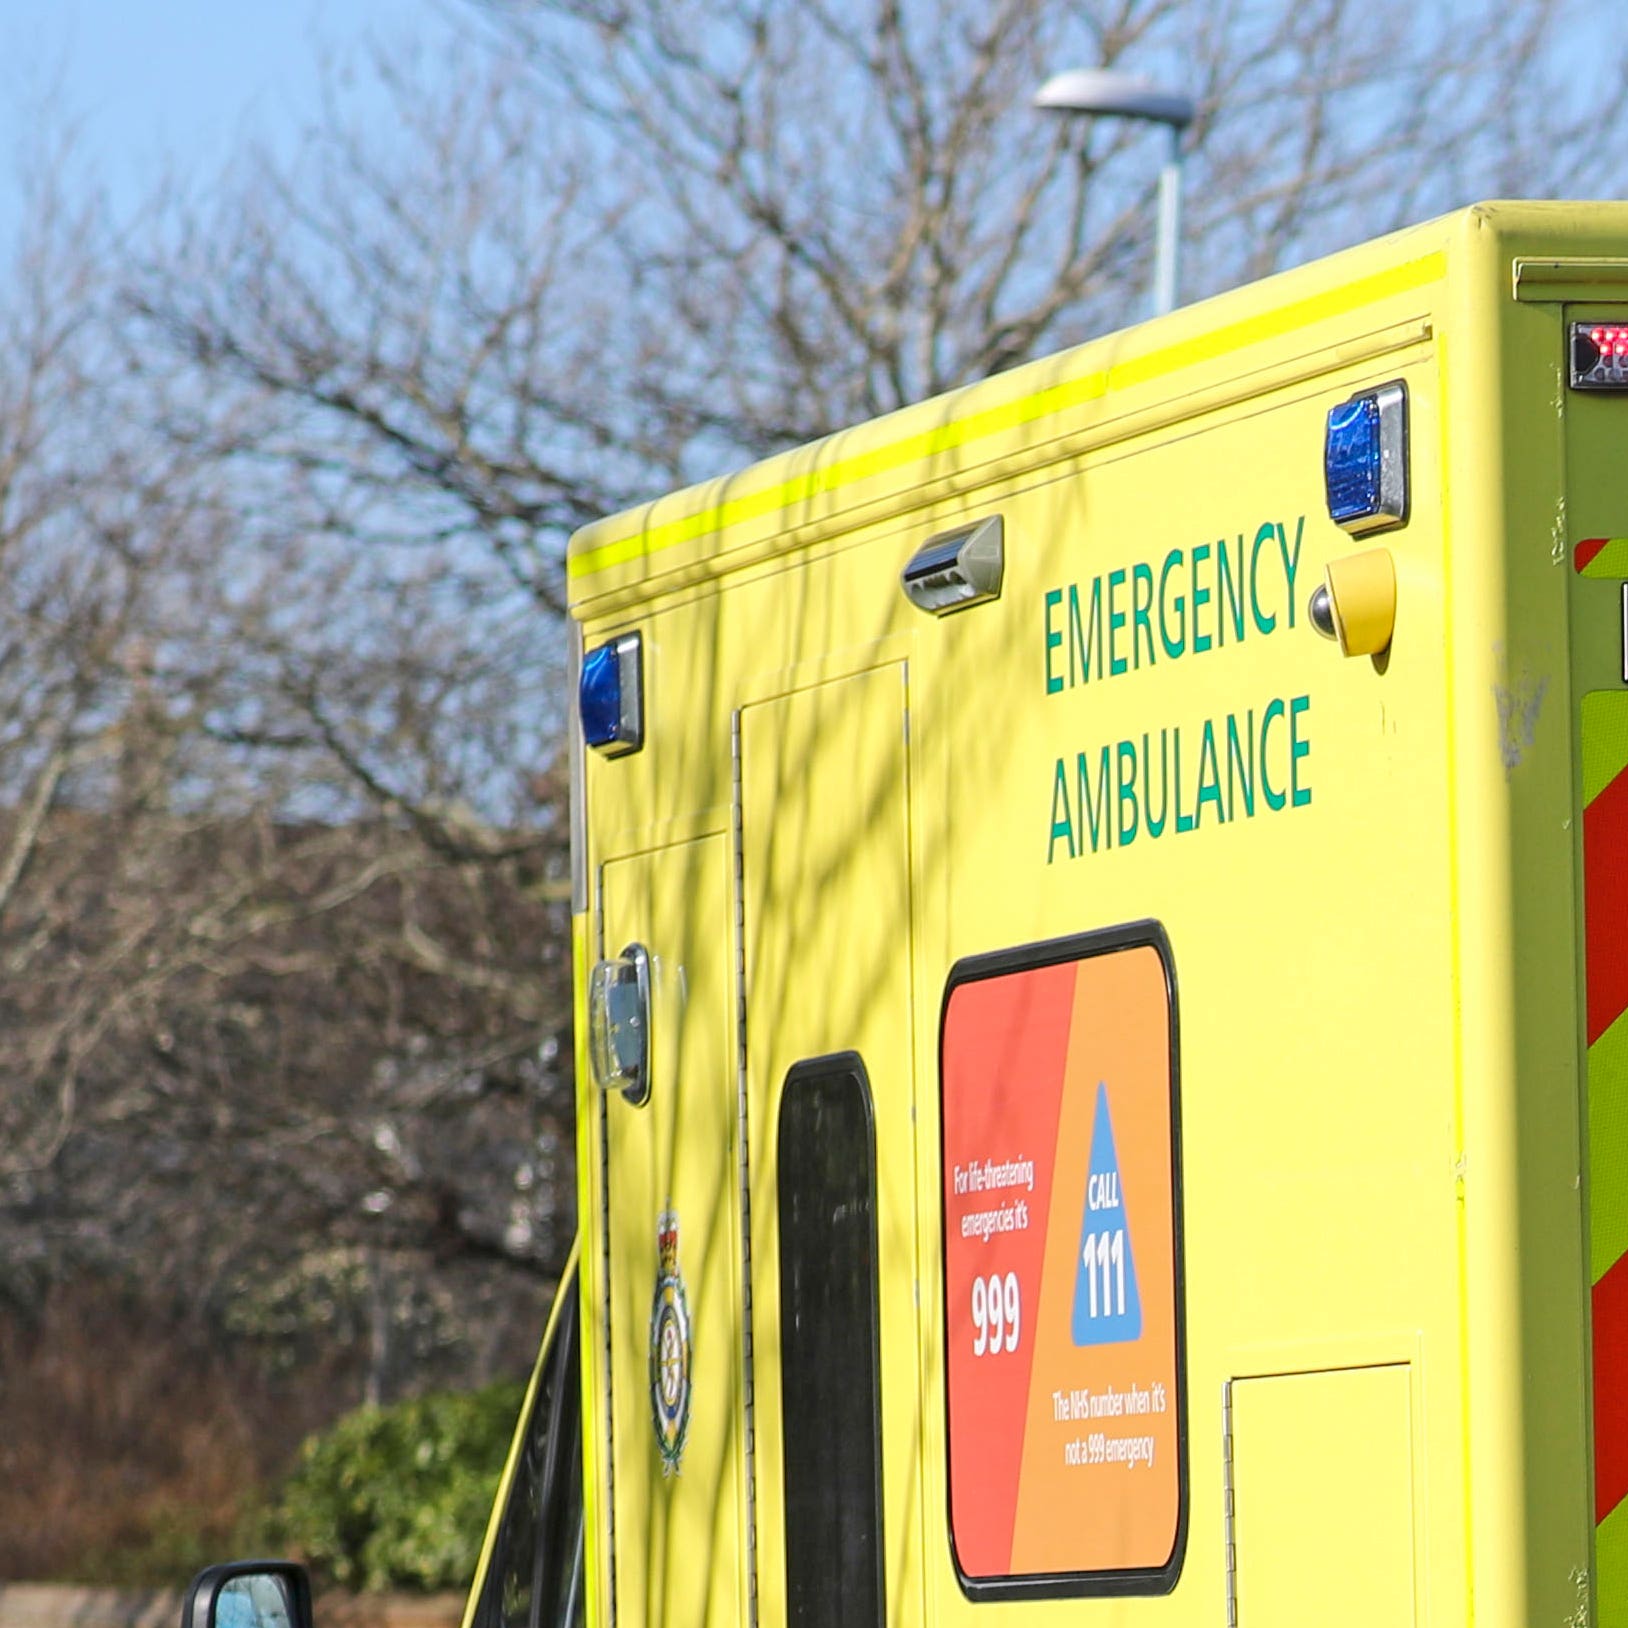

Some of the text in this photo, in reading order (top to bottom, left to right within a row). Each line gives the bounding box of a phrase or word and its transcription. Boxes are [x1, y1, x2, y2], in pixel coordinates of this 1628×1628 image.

[1044, 516, 1305, 695] EMERGENCY
[1048, 695, 1312, 865] AMBULANCE
[954, 1154, 1034, 1195] For life-threatening
[1088, 1172, 1119, 1211] CALL
[961, 1201, 1014, 1243] emergencies
[1083, 1229, 1125, 1318] 111
[972, 1271, 1020, 1357] 999
[1052, 1381, 1166, 1422] The NHS number when it's
[1064, 1432, 1154, 1470] not a 999 emergency
